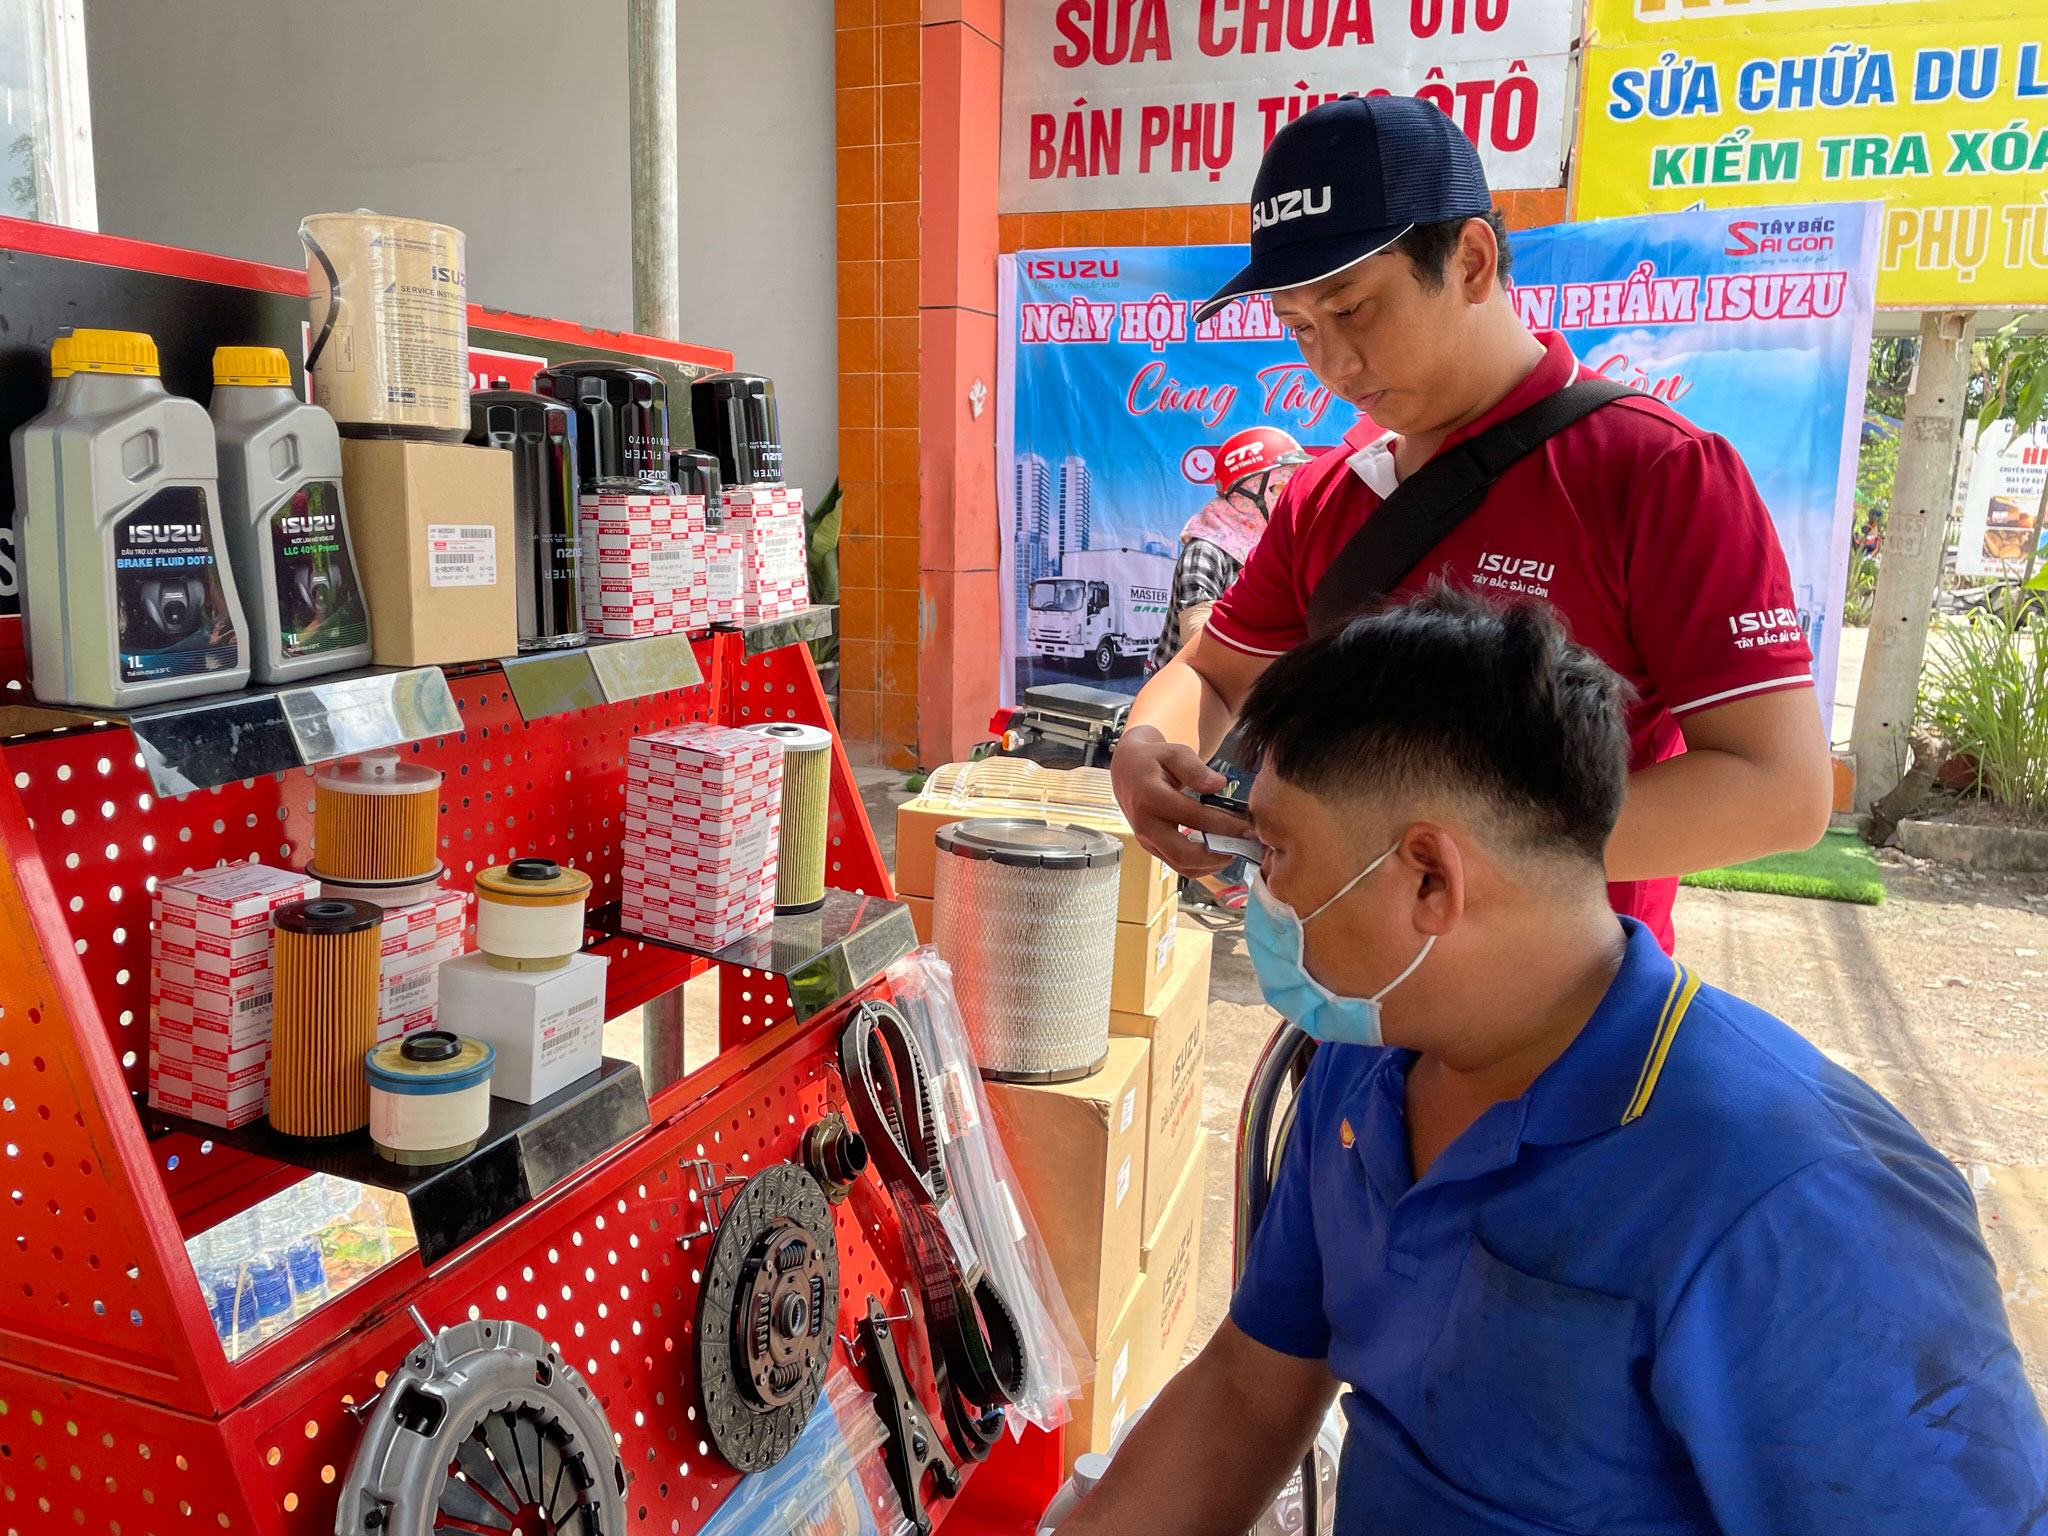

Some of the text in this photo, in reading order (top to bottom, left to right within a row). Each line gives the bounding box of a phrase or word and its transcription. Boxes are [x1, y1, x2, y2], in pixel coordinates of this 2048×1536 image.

[1609, 53, 1720, 120] SỬA
[1738, 44, 1896, 112] CHỮA
[1914, 47, 2000, 102] DU
[1029, 97, 1123, 180] BÁN
[1139, 101, 1235, 182] PHỤ
[1652, 128, 1800, 187] KIỂM
[1820, 135, 1930, 178] TRA
[1759, 216, 1835, 235] TÂY BẮC
[1882, 206, 1992, 282] PHỤ
[1027, 259, 1120, 279] ISUZU
[400, 285, 435, 297] SERVICE
[1020, 296, 1116, 343] NGÀY
[1118, 293, 1187, 351] HỘI
[1560, 261, 1699, 329] PHẨM
[1704, 271, 1848, 322] ISUZU
[1127, 361, 1238, 428] Cùng
[624, 449, 661, 461] FILTER
[128, 524, 201, 544] ISUZU
[281, 514, 336, 534] ISUZU
[604, 527, 626, 535] ISUZU
[283, 546, 299, 556] LLC
[300, 544, 317, 554] 40%
[116, 555, 213, 569] BRAKE FLUID DOT 3
[1477, 552, 1555, 582] ISUZU
[1130, 588, 1168, 601] MASTER
[1471, 573, 1549, 599] TÂY BẮC SÀI GÒN
[1728, 607, 1798, 635] ISUZU
[287, 633, 300, 646] 1L
[1734, 636, 1754, 649] TÂY
[1757, 629, 1778, 646] BẮC
[127, 655, 144, 669] 1L
[1171, 1018, 1200, 1090] ISUZU
[1161, 1216, 1193, 1304] ISUZU
